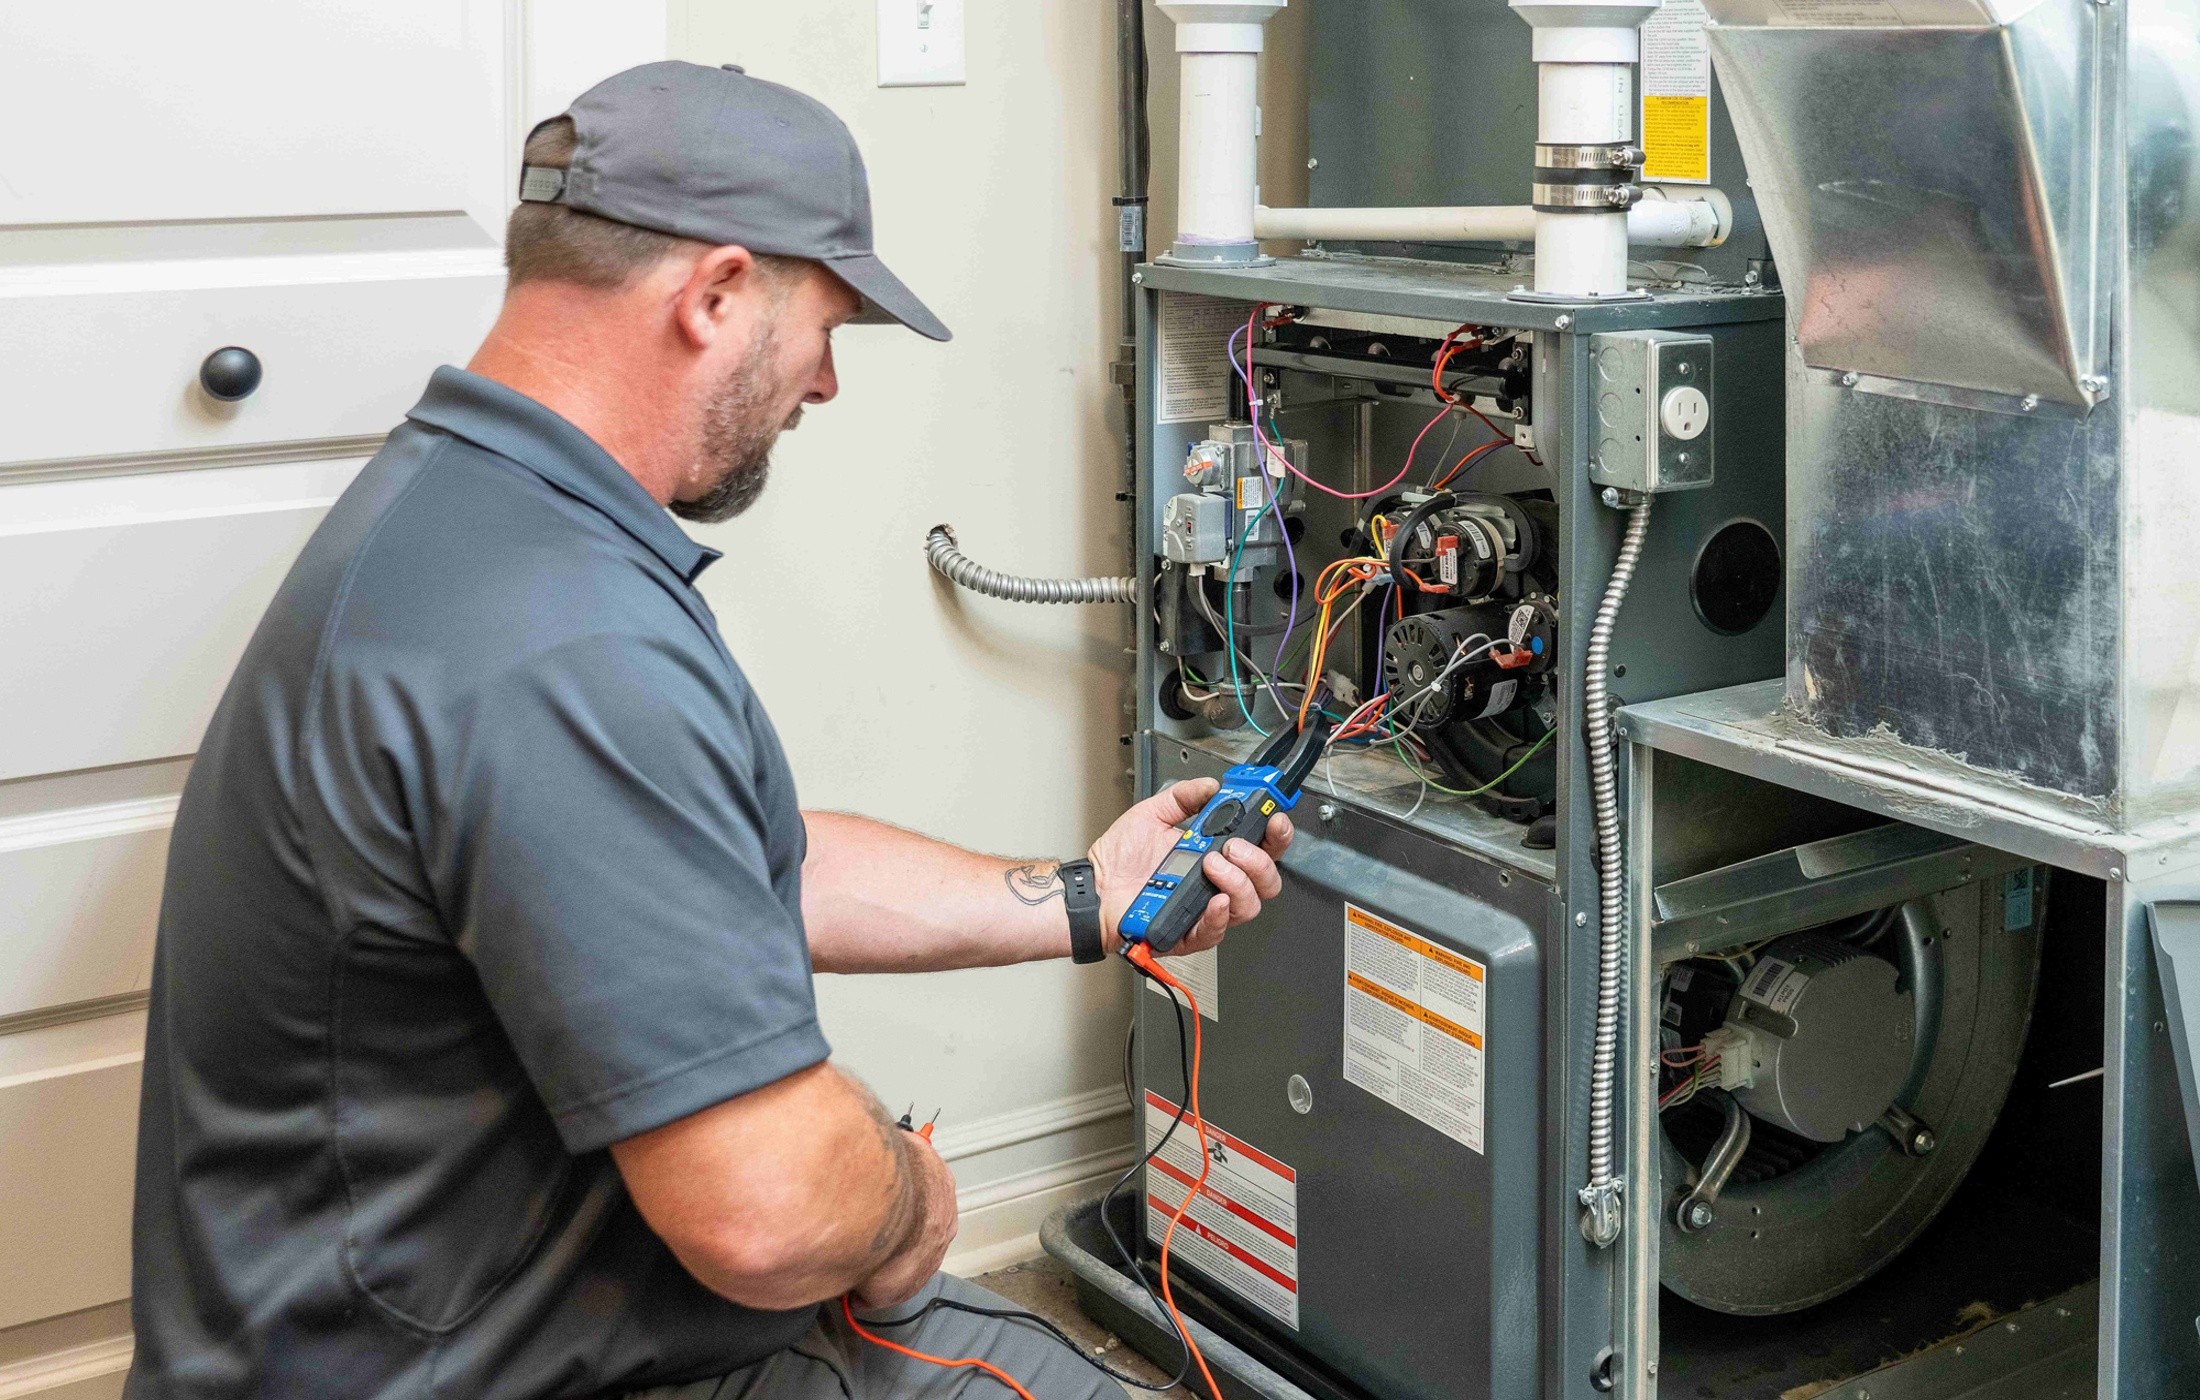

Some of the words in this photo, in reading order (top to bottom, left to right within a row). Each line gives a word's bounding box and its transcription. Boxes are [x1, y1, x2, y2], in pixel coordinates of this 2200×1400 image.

[1205, 1125, 1227, 1143] DANGER
[1206, 1189, 1228, 1207] DANGER
[1207, 1232, 1230, 1250] PELIGRO
